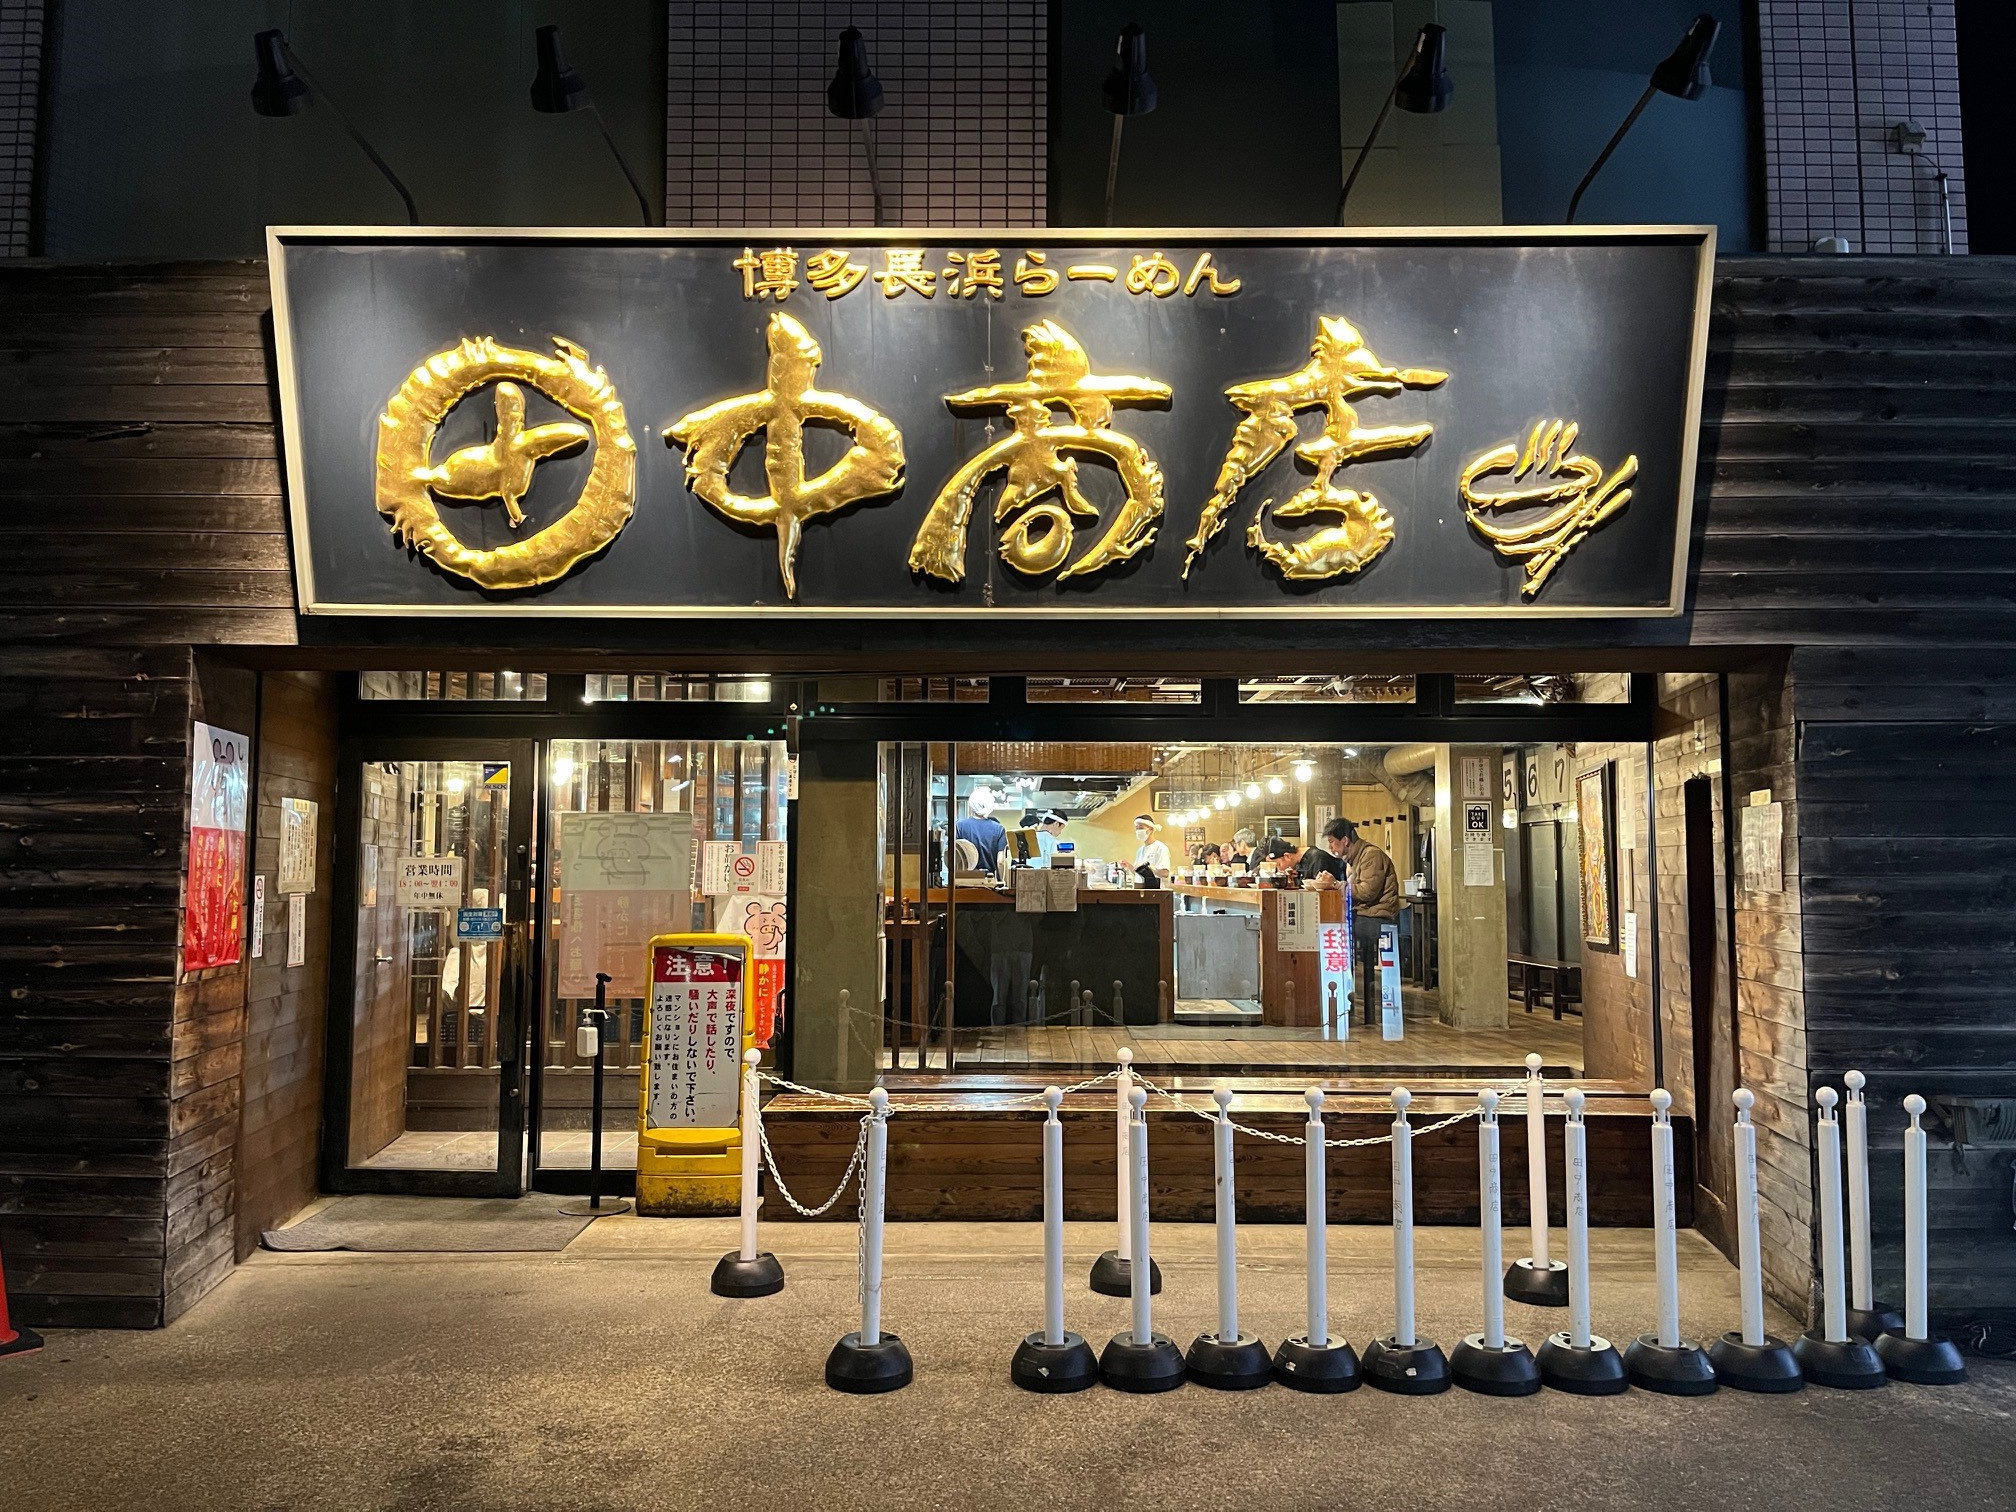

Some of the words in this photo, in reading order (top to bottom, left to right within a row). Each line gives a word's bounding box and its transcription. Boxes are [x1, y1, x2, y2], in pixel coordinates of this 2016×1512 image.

[733, 246, 1242, 300] 博多長浜らーめん
[376, 311, 1450, 599] 田中商店
[1503, 769, 1512, 801] 5
[1528, 763, 1538, 797] 6
[1554, 758, 1565, 793] 7
[404, 864, 453, 877] 営業時間
[413, 891, 444, 900] 年中無休
[705, 989, 718, 1075] 大声で話したり、
[724, 989, 736, 1063] 深夜ですので、
